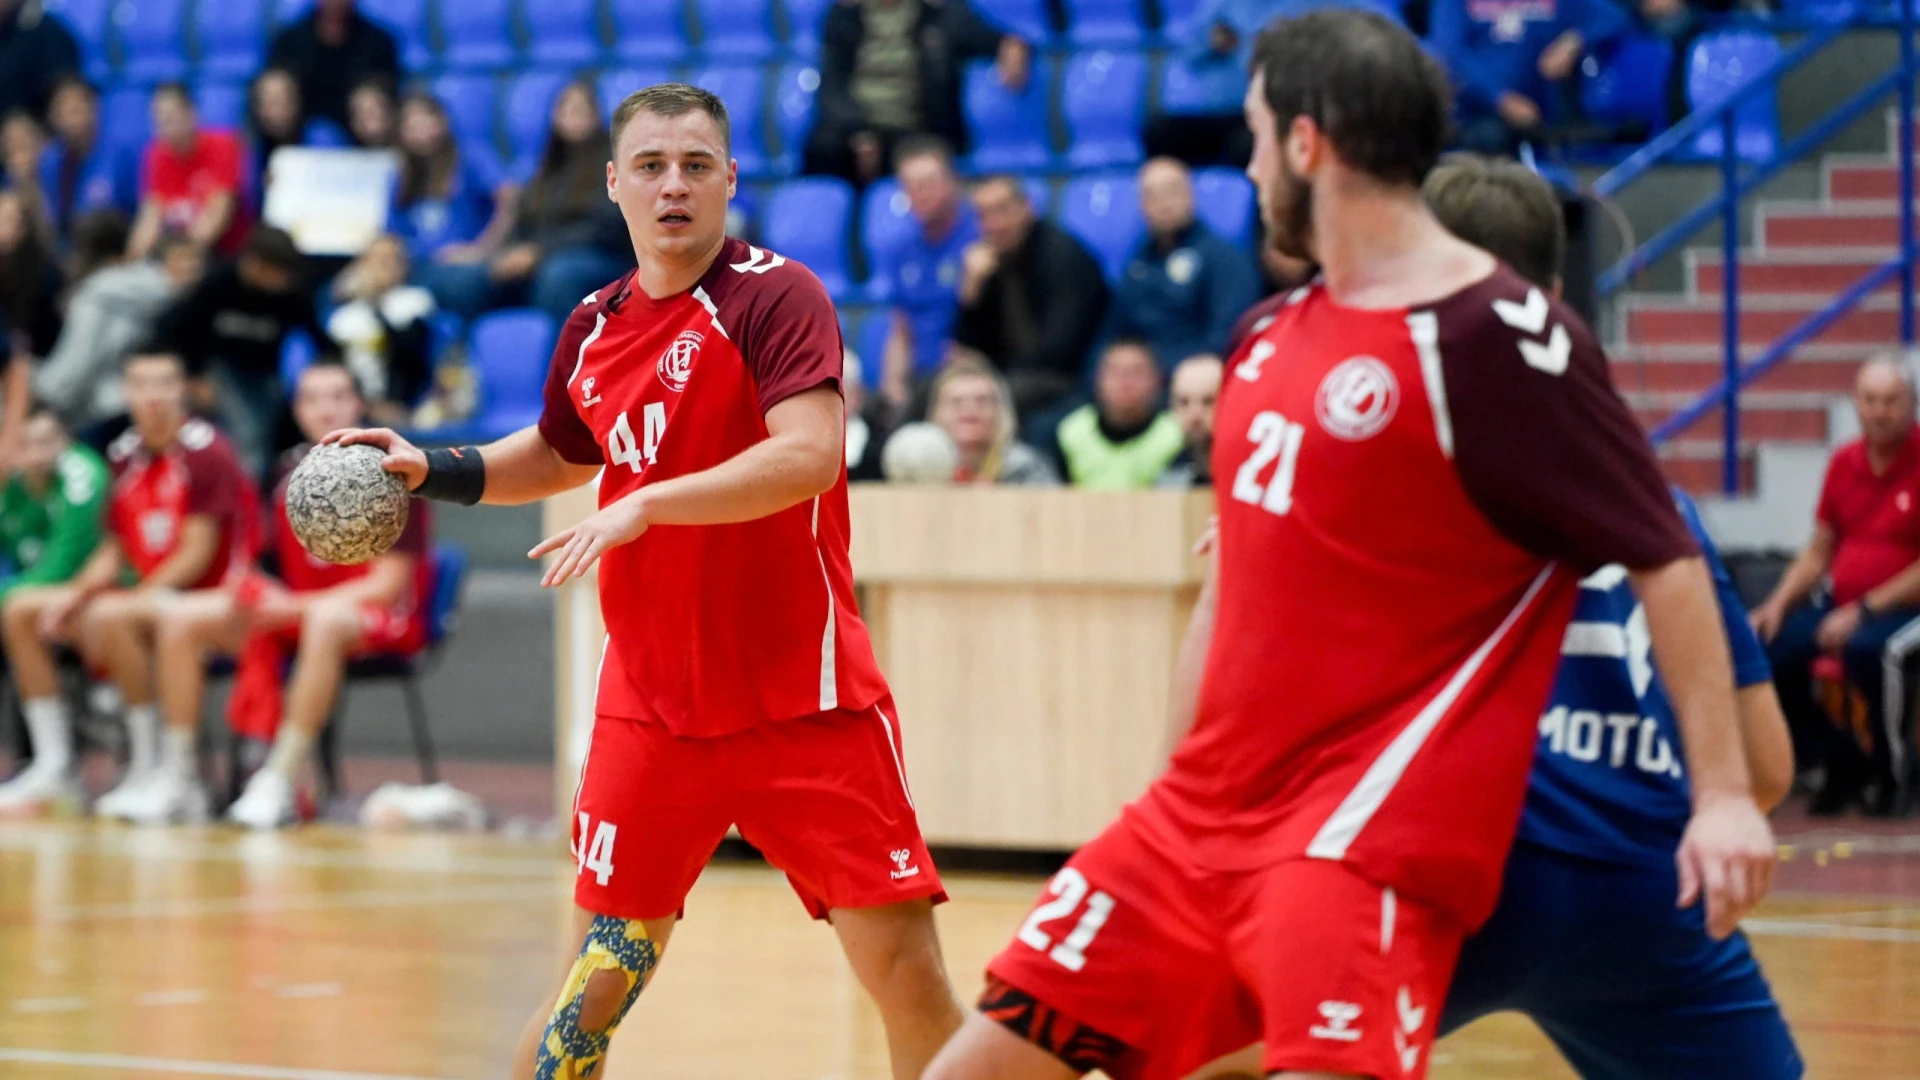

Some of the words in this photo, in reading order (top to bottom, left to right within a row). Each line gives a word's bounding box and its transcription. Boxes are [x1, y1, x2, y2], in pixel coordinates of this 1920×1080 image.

[608, 402, 667, 474] 44
[1232, 410, 1305, 517] 21
[1538, 705, 1683, 778] MOTO
[1016, 866, 1117, 973] 21
